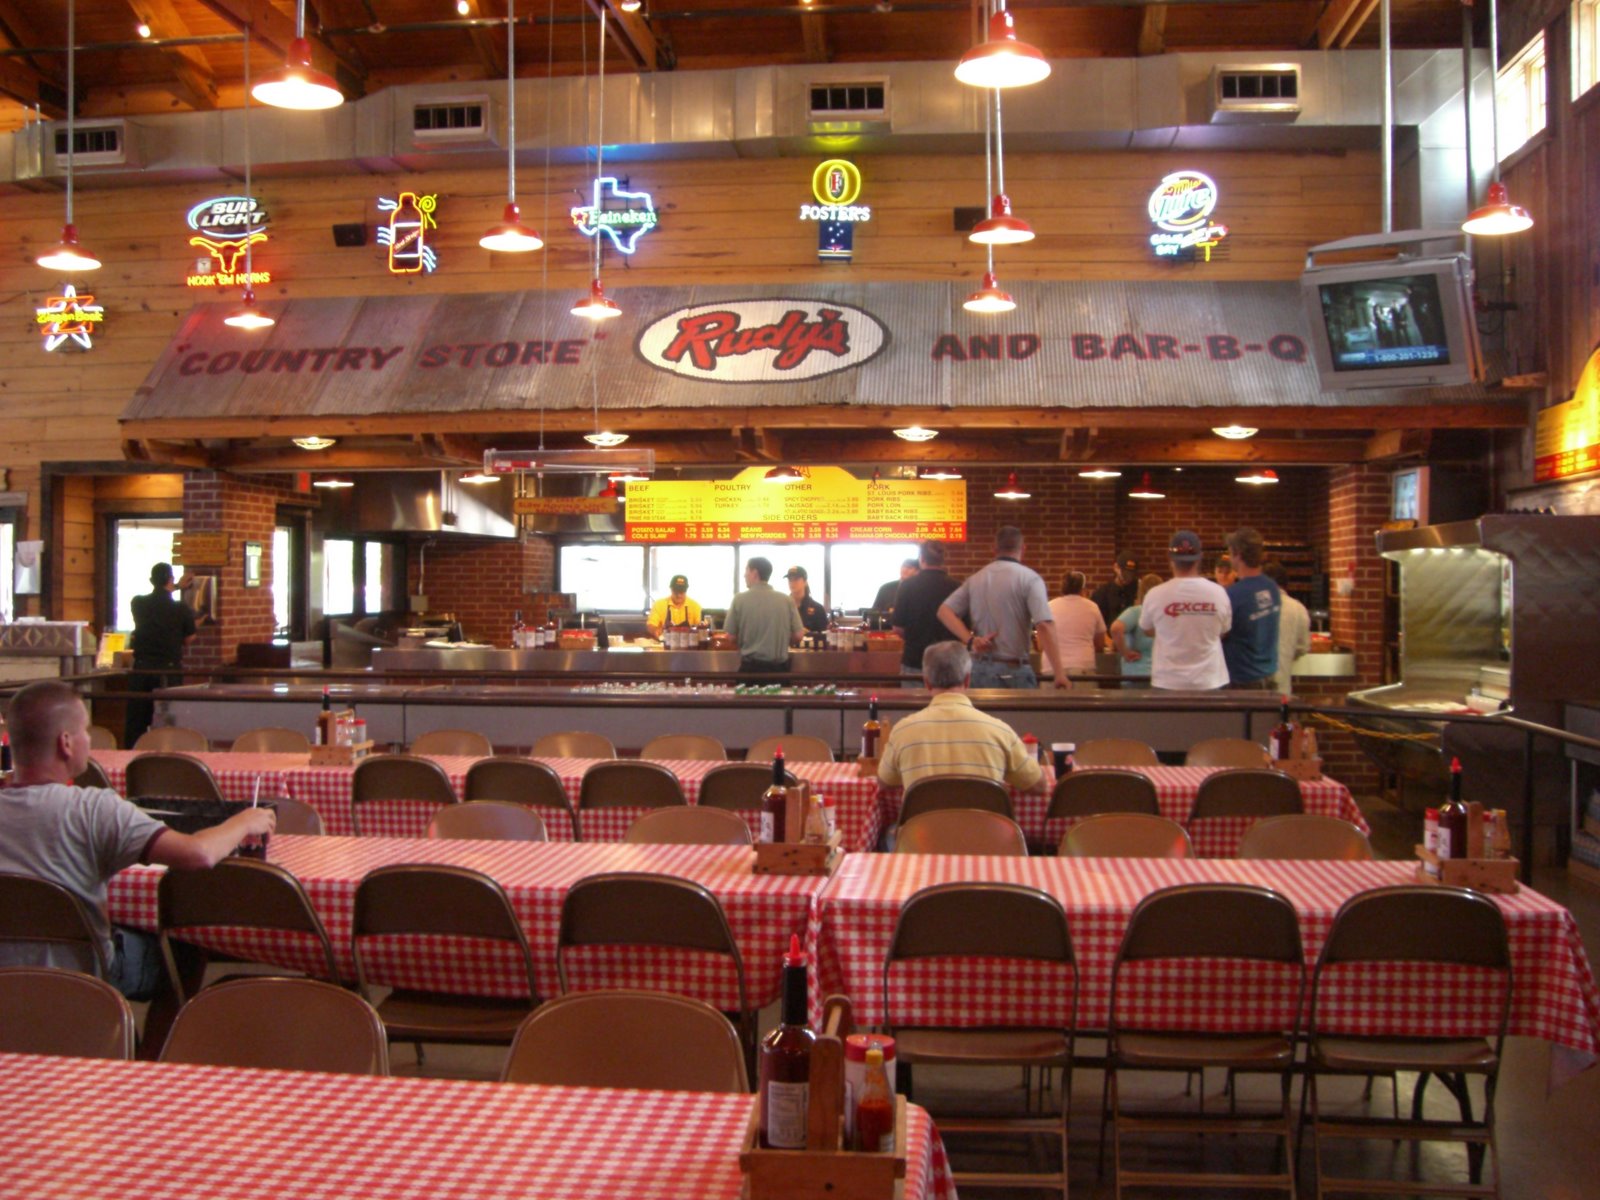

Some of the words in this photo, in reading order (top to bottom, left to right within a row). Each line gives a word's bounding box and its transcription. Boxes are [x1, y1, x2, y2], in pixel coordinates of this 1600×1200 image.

[211, 201, 258, 215] BUD
[200, 212, 266, 227] LIGHT
[589, 209, 657, 225] Heineken
[187, 275, 217, 287] HOOK
[661, 309, 851, 371] Rudy's
[930, 333, 1042, 362] AND
[1070, 333, 1307, 364] BAR-B-Q
[714, 484, 752, 492] POULTRY
[1165, 602, 1217, 614] EXCEL
